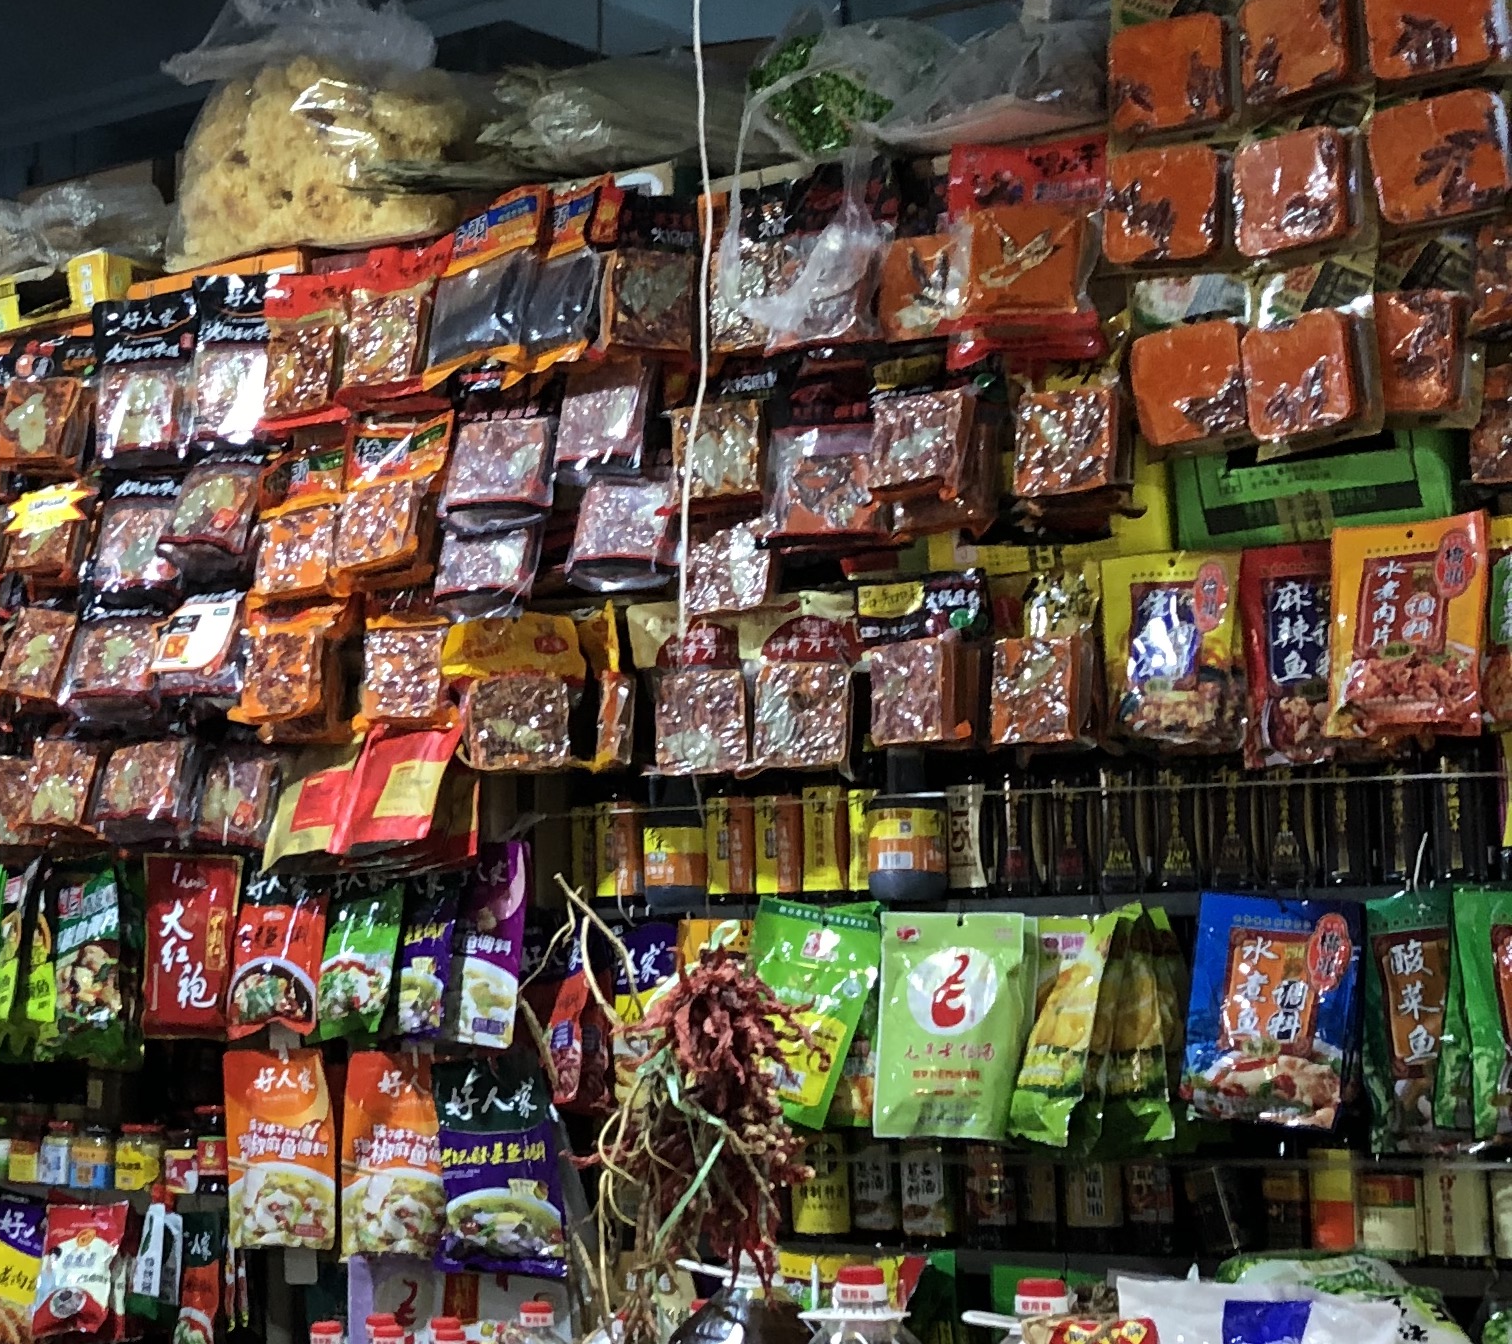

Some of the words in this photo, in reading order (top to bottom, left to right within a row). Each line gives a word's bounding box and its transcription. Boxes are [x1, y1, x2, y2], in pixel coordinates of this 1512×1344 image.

[120, 304, 180, 330] 好人家
[1273, 581, 1314, 683] 麻辣鱼
[1371, 560, 1406, 649] 水煮肉片
[159, 898, 218, 1009] 大红袍
[1229, 936, 1279, 1045] 水煮鱼
[1390, 938, 1445, 1067] 酸菜鱼
[253, 1067, 316, 1094] 好人家
[445, 1076, 538, 1121] 好人家
